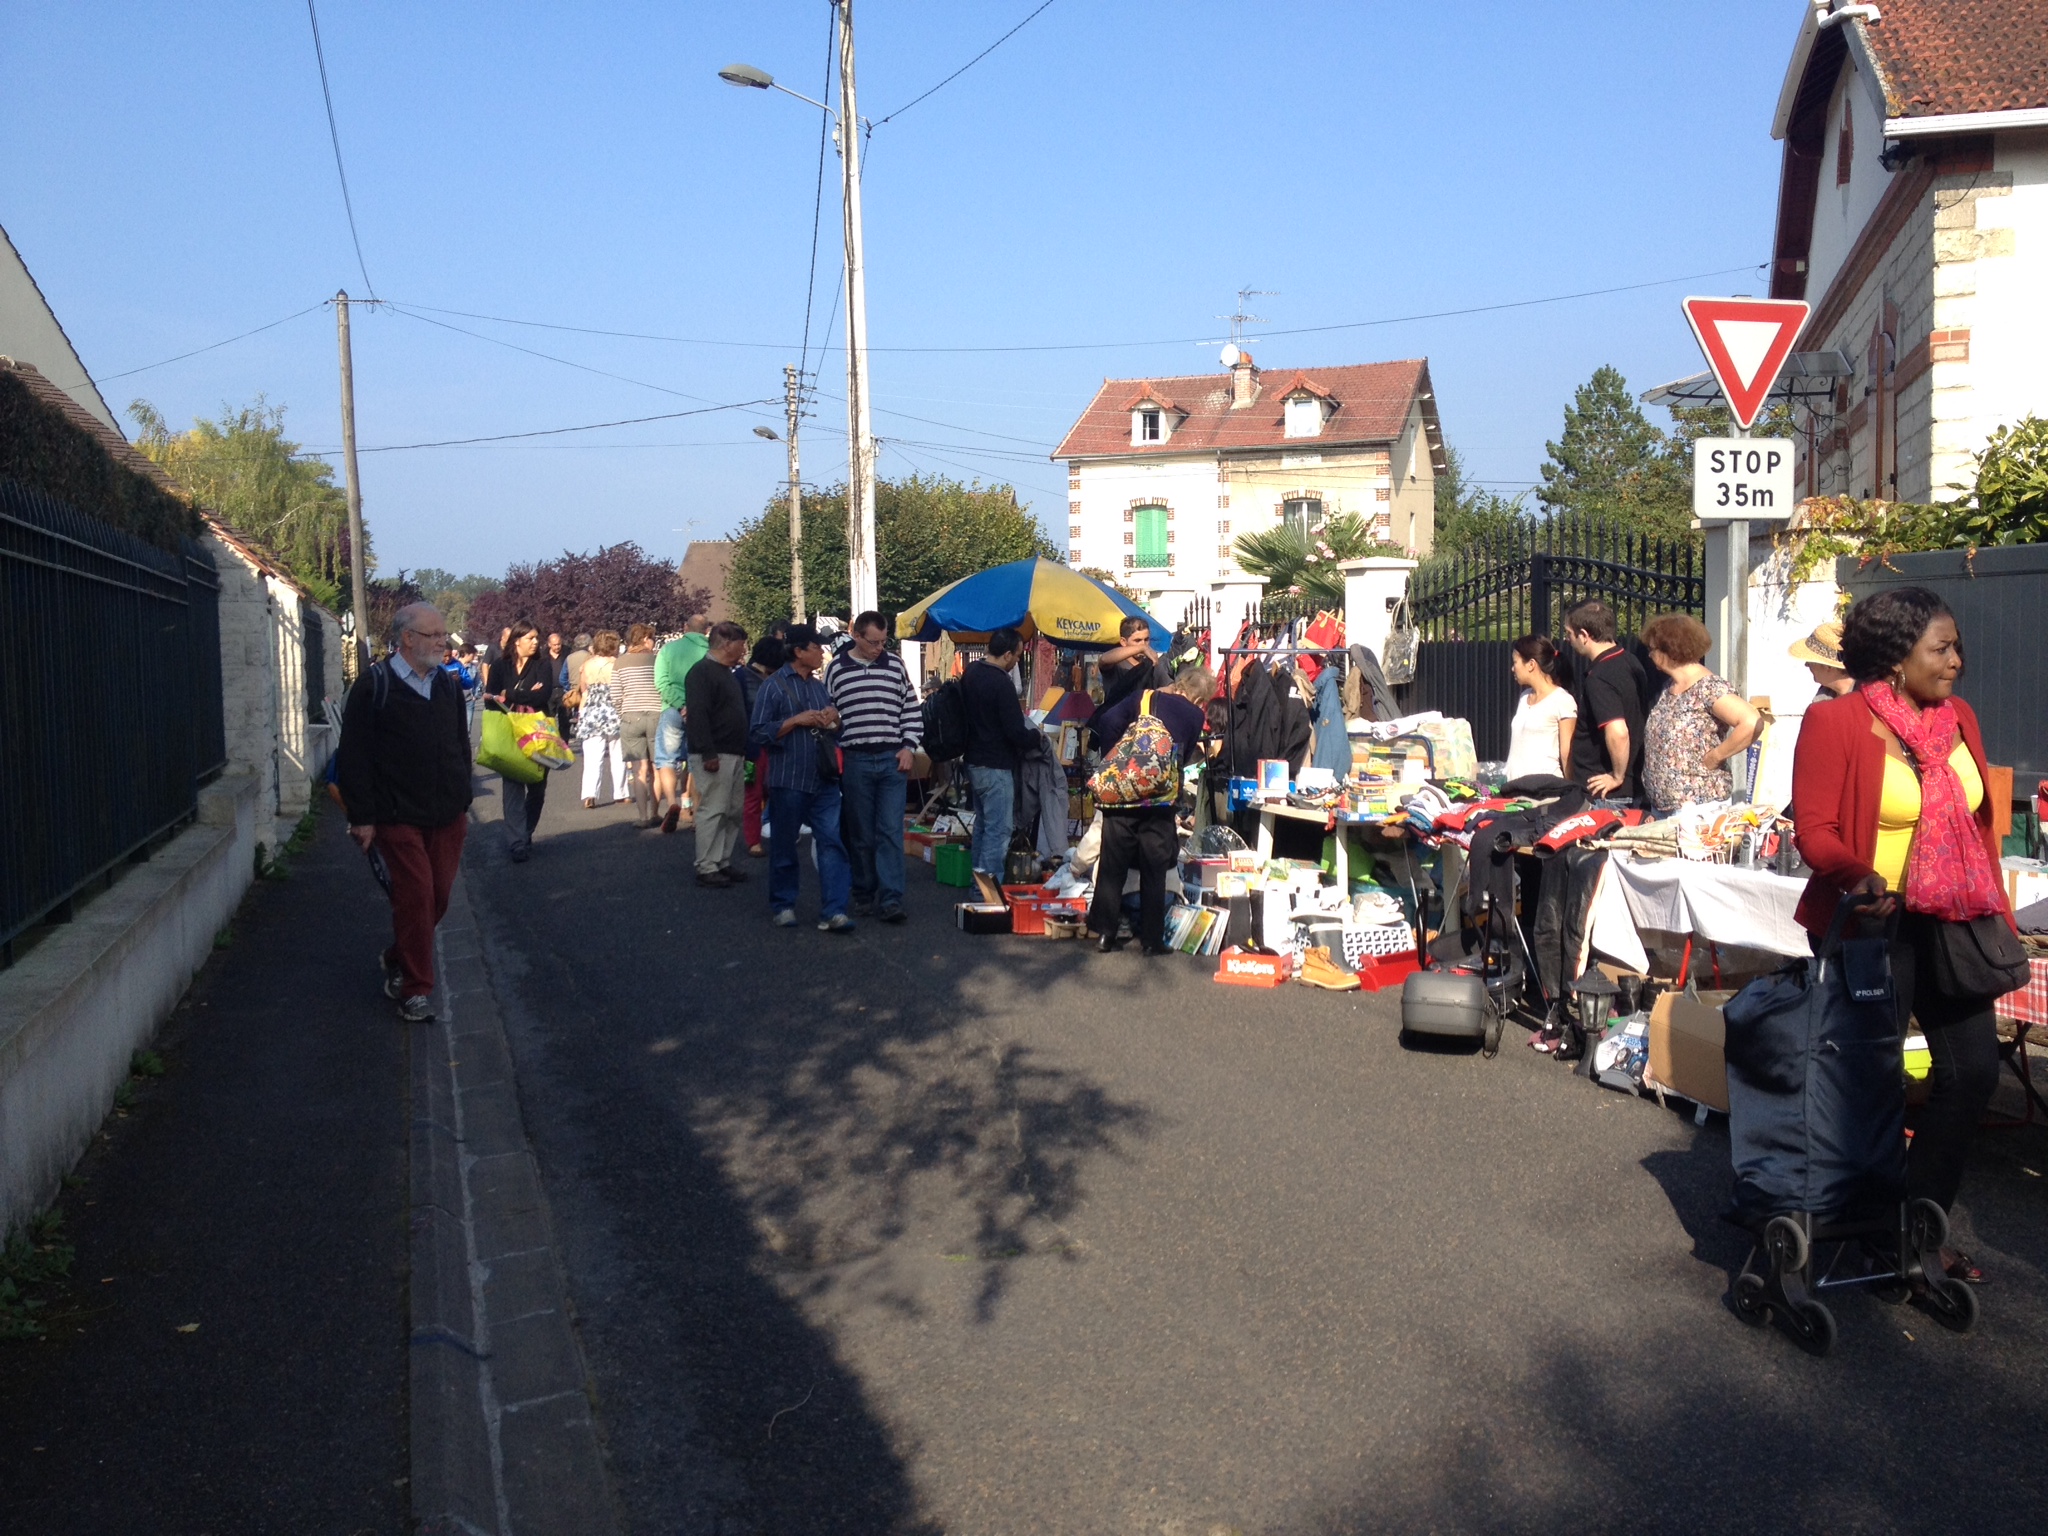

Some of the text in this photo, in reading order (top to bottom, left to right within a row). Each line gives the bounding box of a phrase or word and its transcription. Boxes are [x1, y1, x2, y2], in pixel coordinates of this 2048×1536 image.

[1711, 450, 1781, 474] STOP
[1717, 483, 1774, 507] 35m
[1216, 601, 1221, 613] 12
[1056, 617, 1101, 631] KEYCAMP
[1861, 988, 1885, 997] ROLSER
